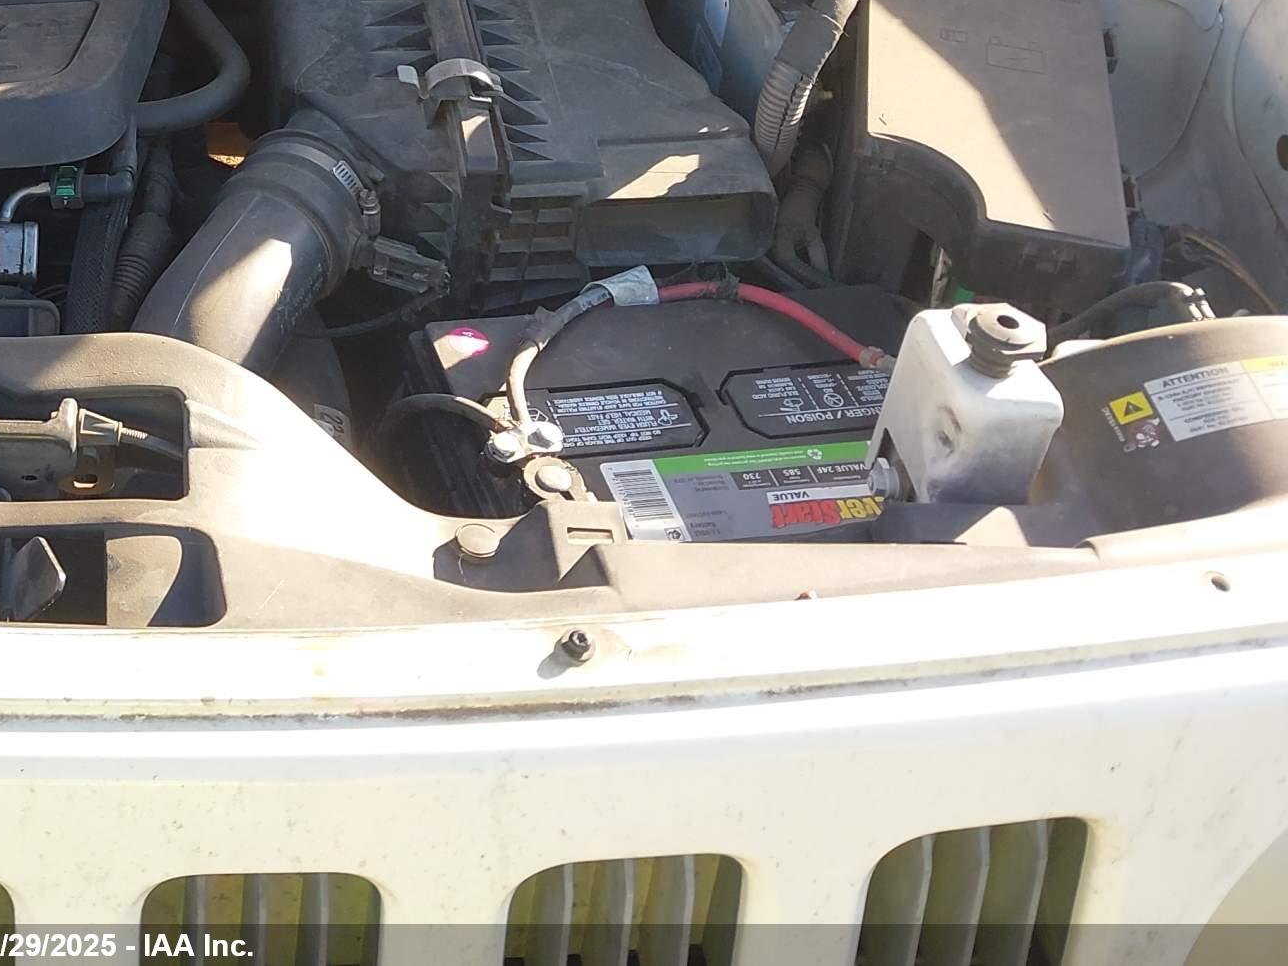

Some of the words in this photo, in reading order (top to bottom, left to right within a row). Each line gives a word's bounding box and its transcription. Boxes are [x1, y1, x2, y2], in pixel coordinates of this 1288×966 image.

[1162, 367, 1229, 388] ATTENTION
[785, 411, 833, 424] POISON
[844, 407, 881, 418] NGER
[636, 420, 658, 428] FLUSH
[782, 467, 801, 477] 585
[816, 466, 832, 475] 24F
[833, 462, 867, 473] VALUE
[742, 471, 761, 481] 730
[771, 490, 809, 501] VALUE
[770, 496, 884, 529] verStart
